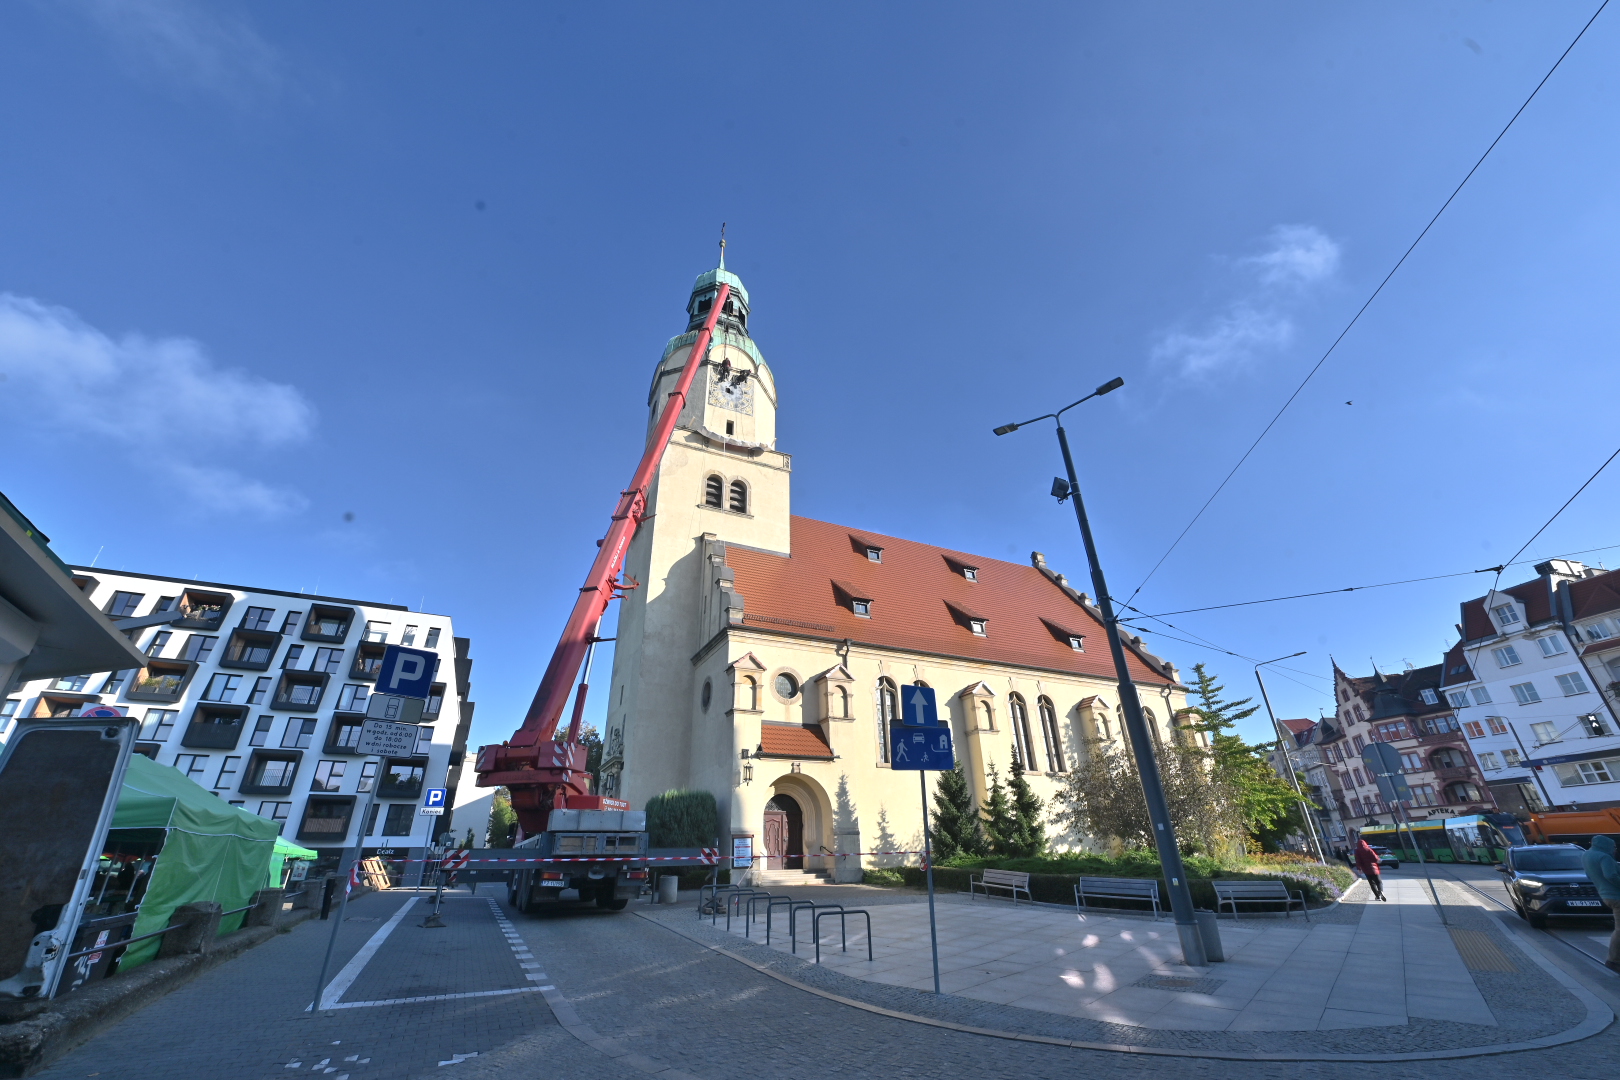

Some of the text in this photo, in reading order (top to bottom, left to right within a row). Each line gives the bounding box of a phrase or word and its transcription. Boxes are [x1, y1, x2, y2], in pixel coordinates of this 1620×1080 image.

[389, 652, 426, 689] P
[429, 790, 442, 805] P
[1427, 808, 1456, 816] APTEKA
